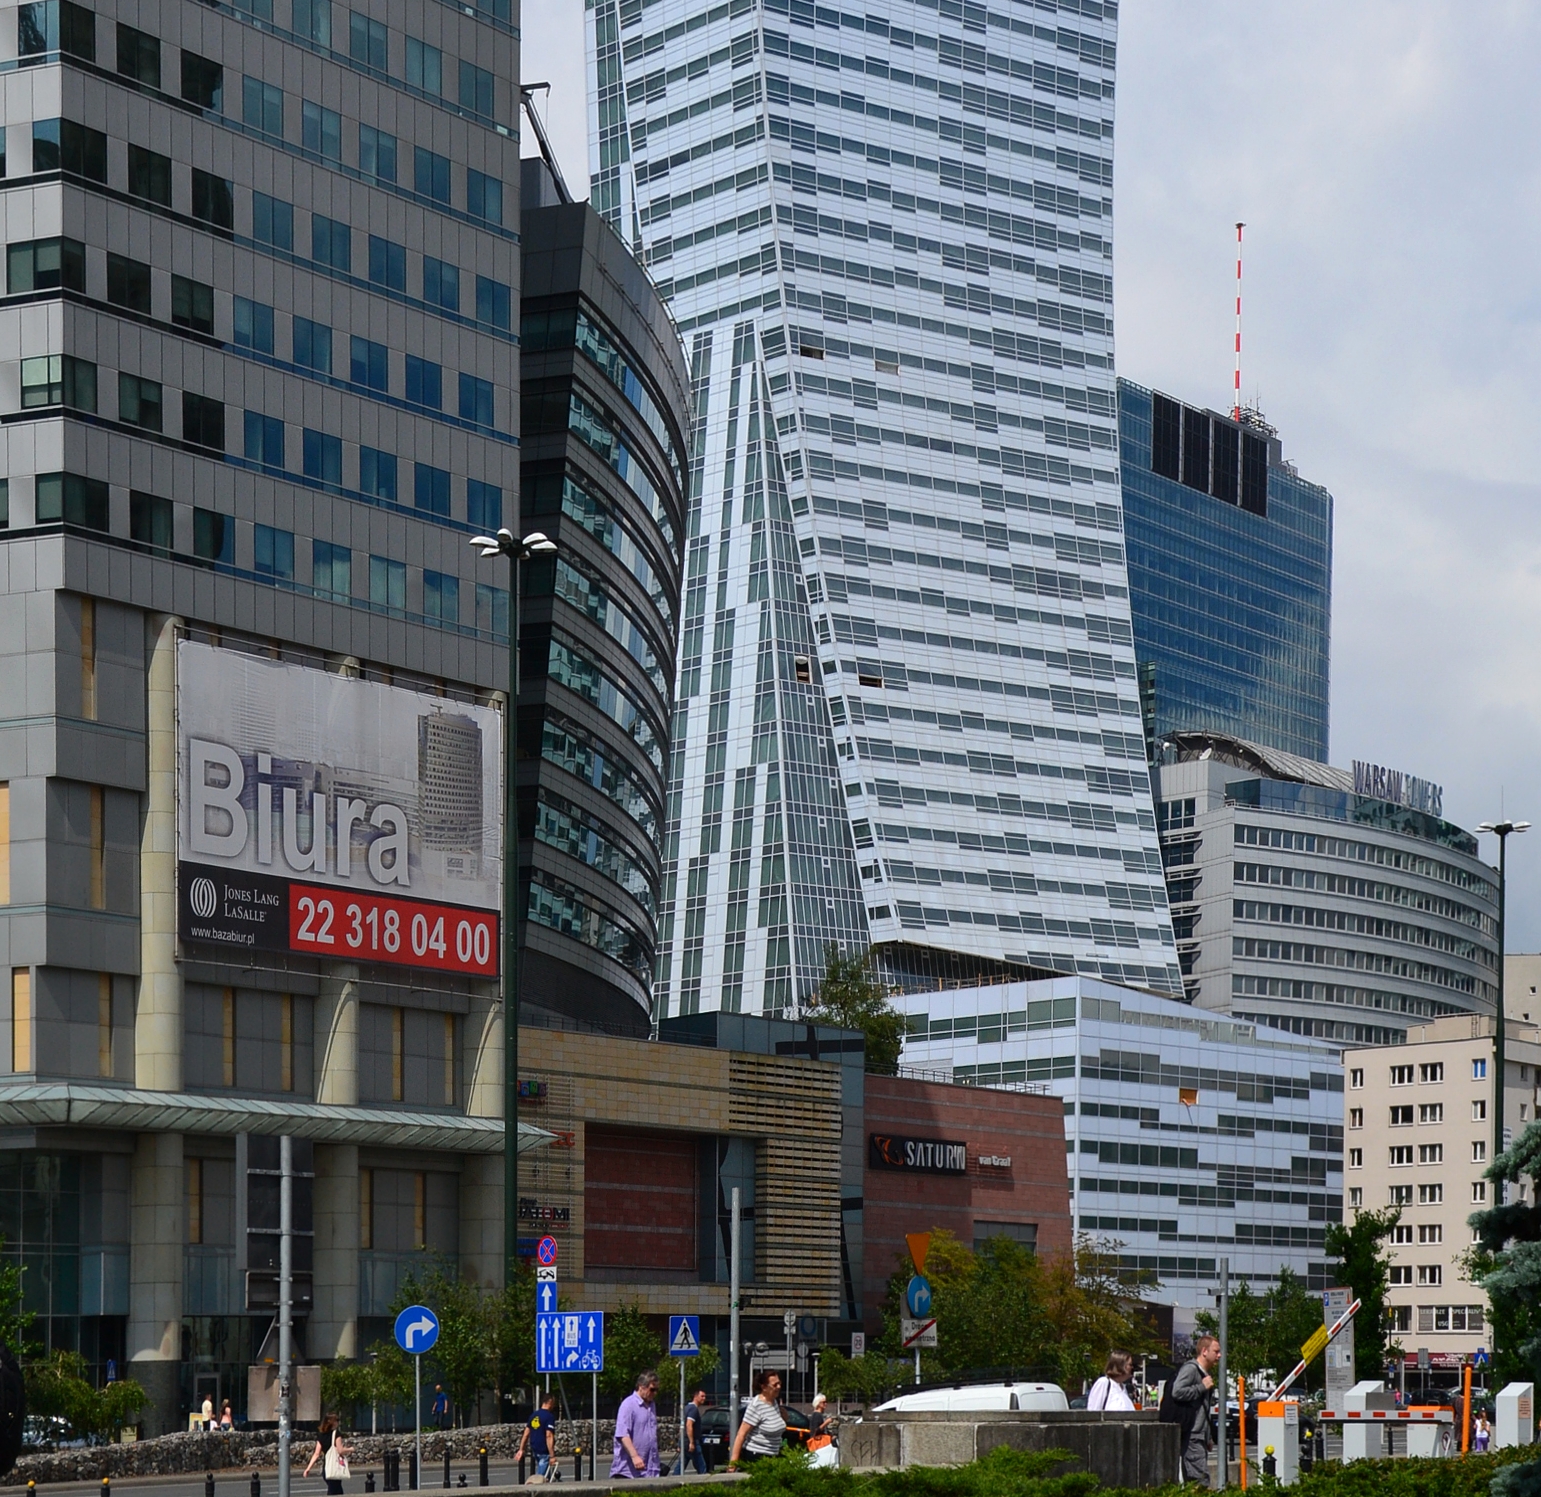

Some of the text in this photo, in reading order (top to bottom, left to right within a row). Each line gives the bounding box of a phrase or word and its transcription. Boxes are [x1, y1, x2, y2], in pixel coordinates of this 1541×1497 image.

[1352, 760, 1443, 817] WARSAW TOWERS
[190, 738, 410, 887] Biura
[191, 927, 255, 946] www.bazabiur.pl
[297, 897, 490, 965] 22 318 04 00
[905, 1141, 966, 1170] SATURN
[979, 1156, 991, 1165] van
